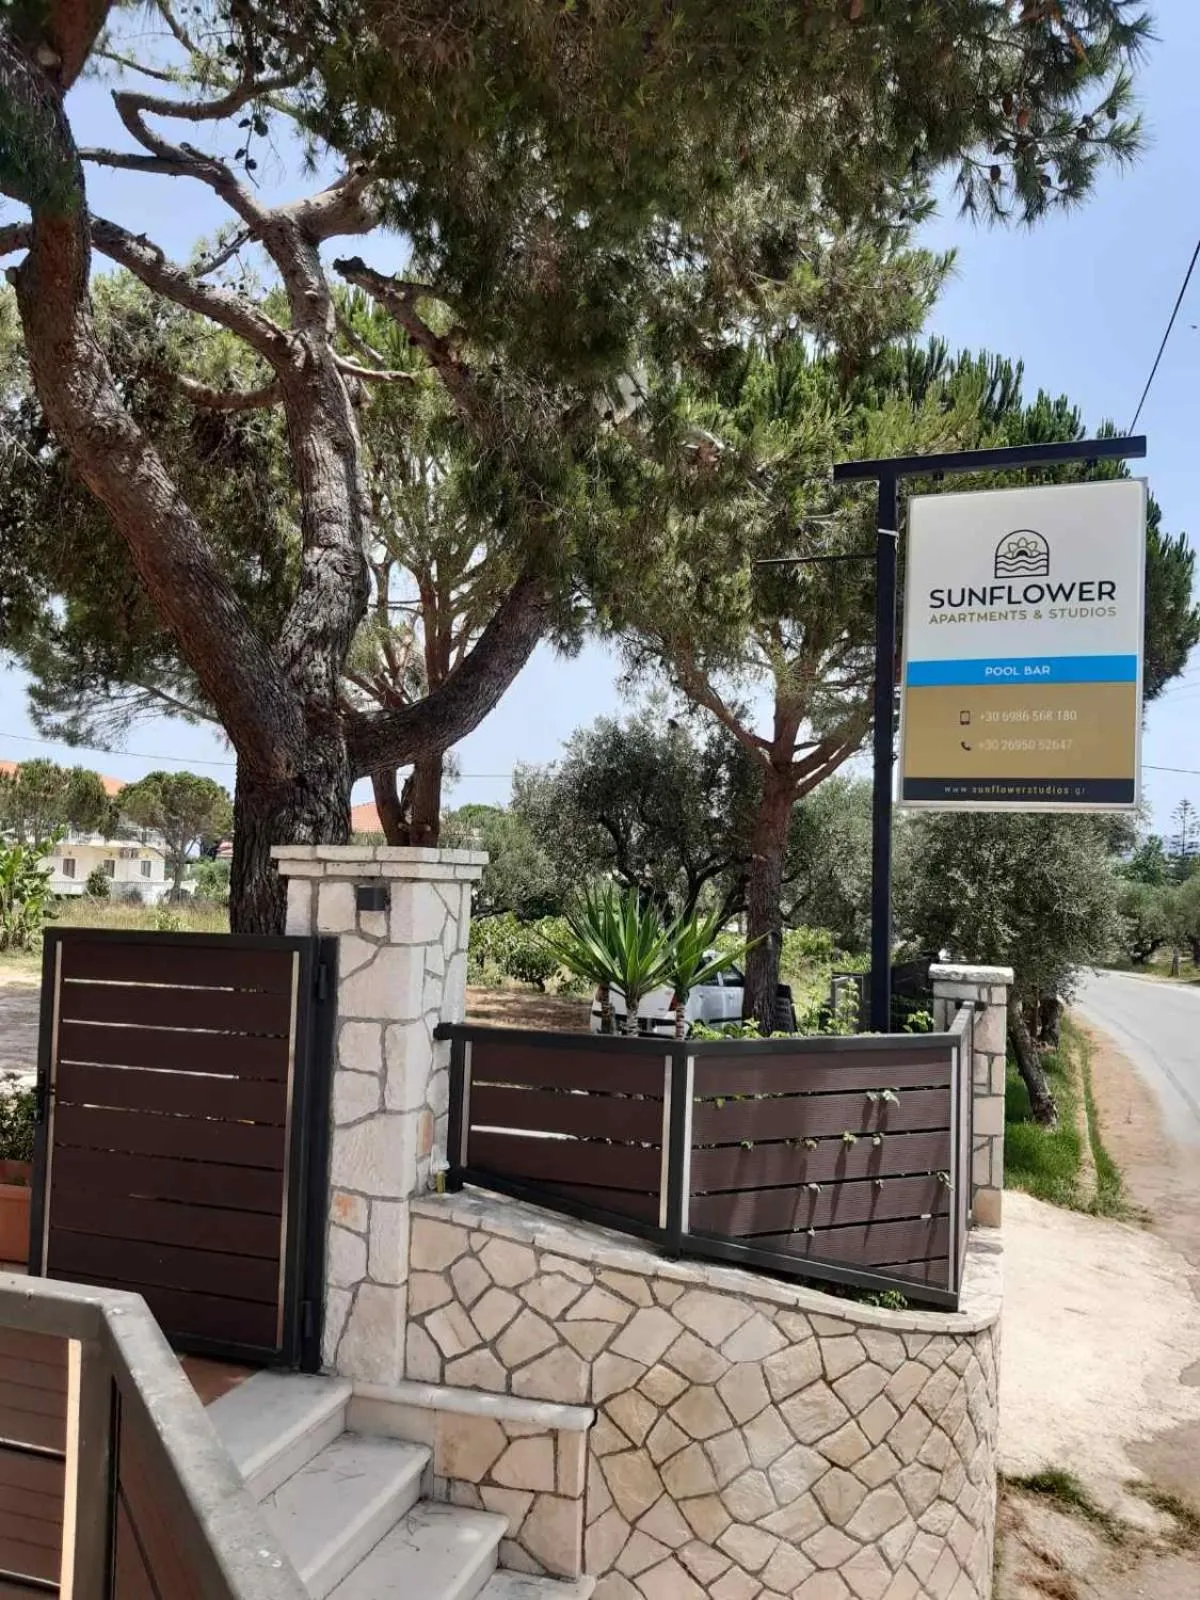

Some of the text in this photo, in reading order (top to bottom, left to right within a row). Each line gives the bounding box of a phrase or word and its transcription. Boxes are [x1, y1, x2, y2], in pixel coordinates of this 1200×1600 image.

[929, 580, 1117, 609] SUNFLOWER
[929, 606, 1117, 625] APARTMENTS & STUDIOS
[985, 665, 1050, 676] POOL BAR
